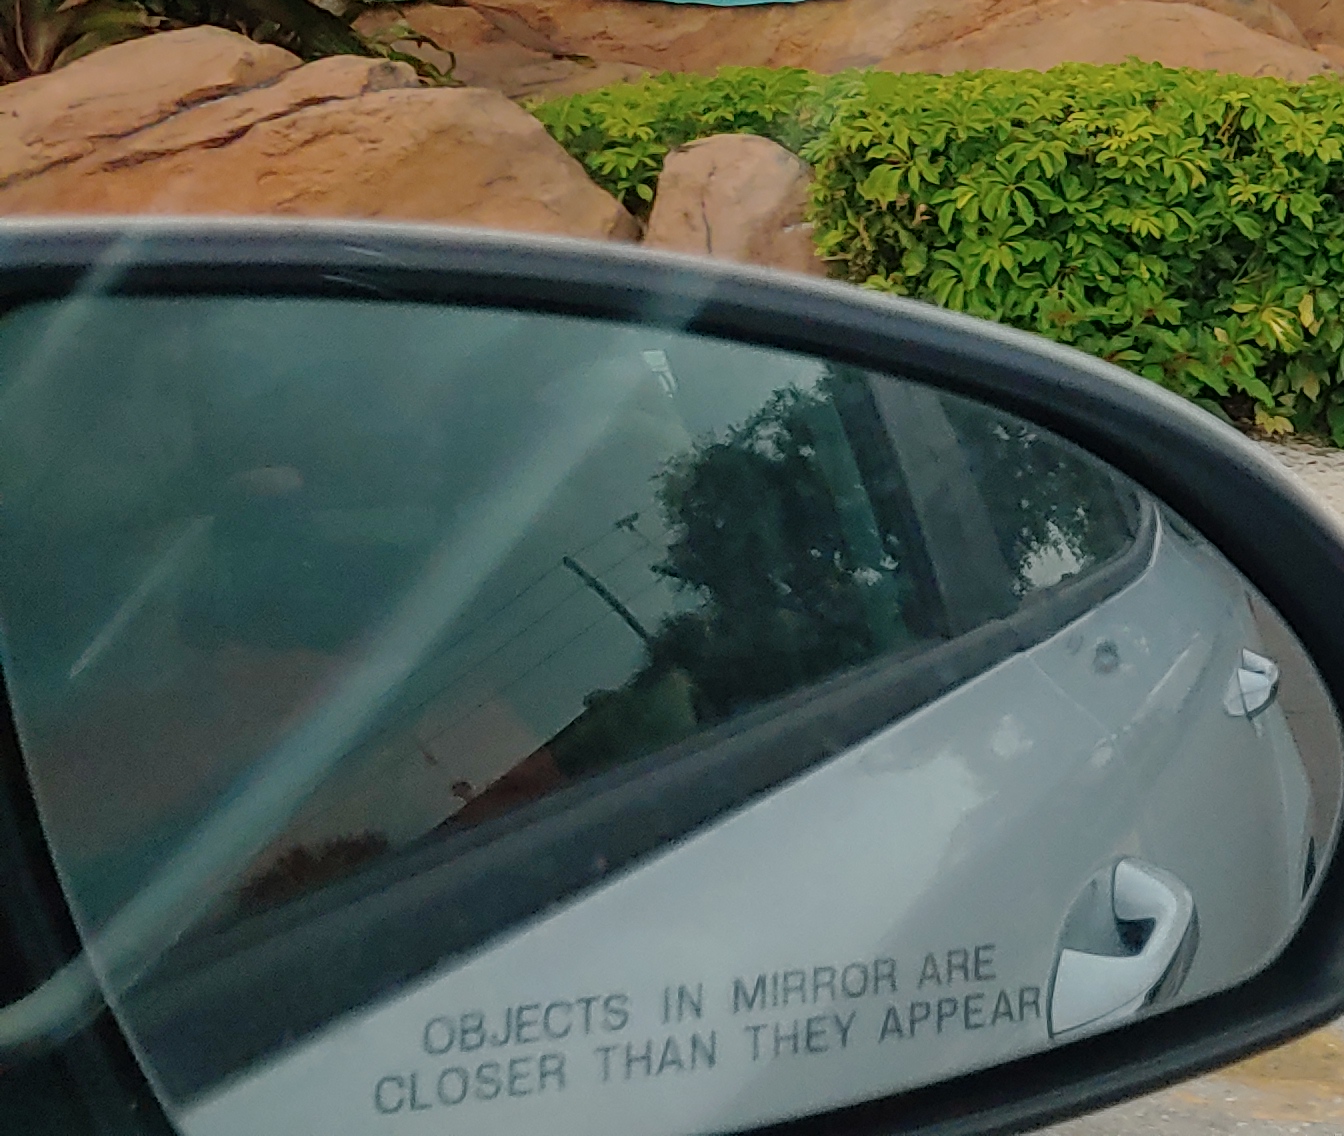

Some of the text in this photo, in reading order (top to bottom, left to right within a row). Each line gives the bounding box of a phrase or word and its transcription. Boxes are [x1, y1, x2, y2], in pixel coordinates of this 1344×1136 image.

[374, 985, 1042, 1115] CLOSER THAN THEY APPEAR
[422, 944, 997, 1056] OBJECTS IN MIRROR ARE
